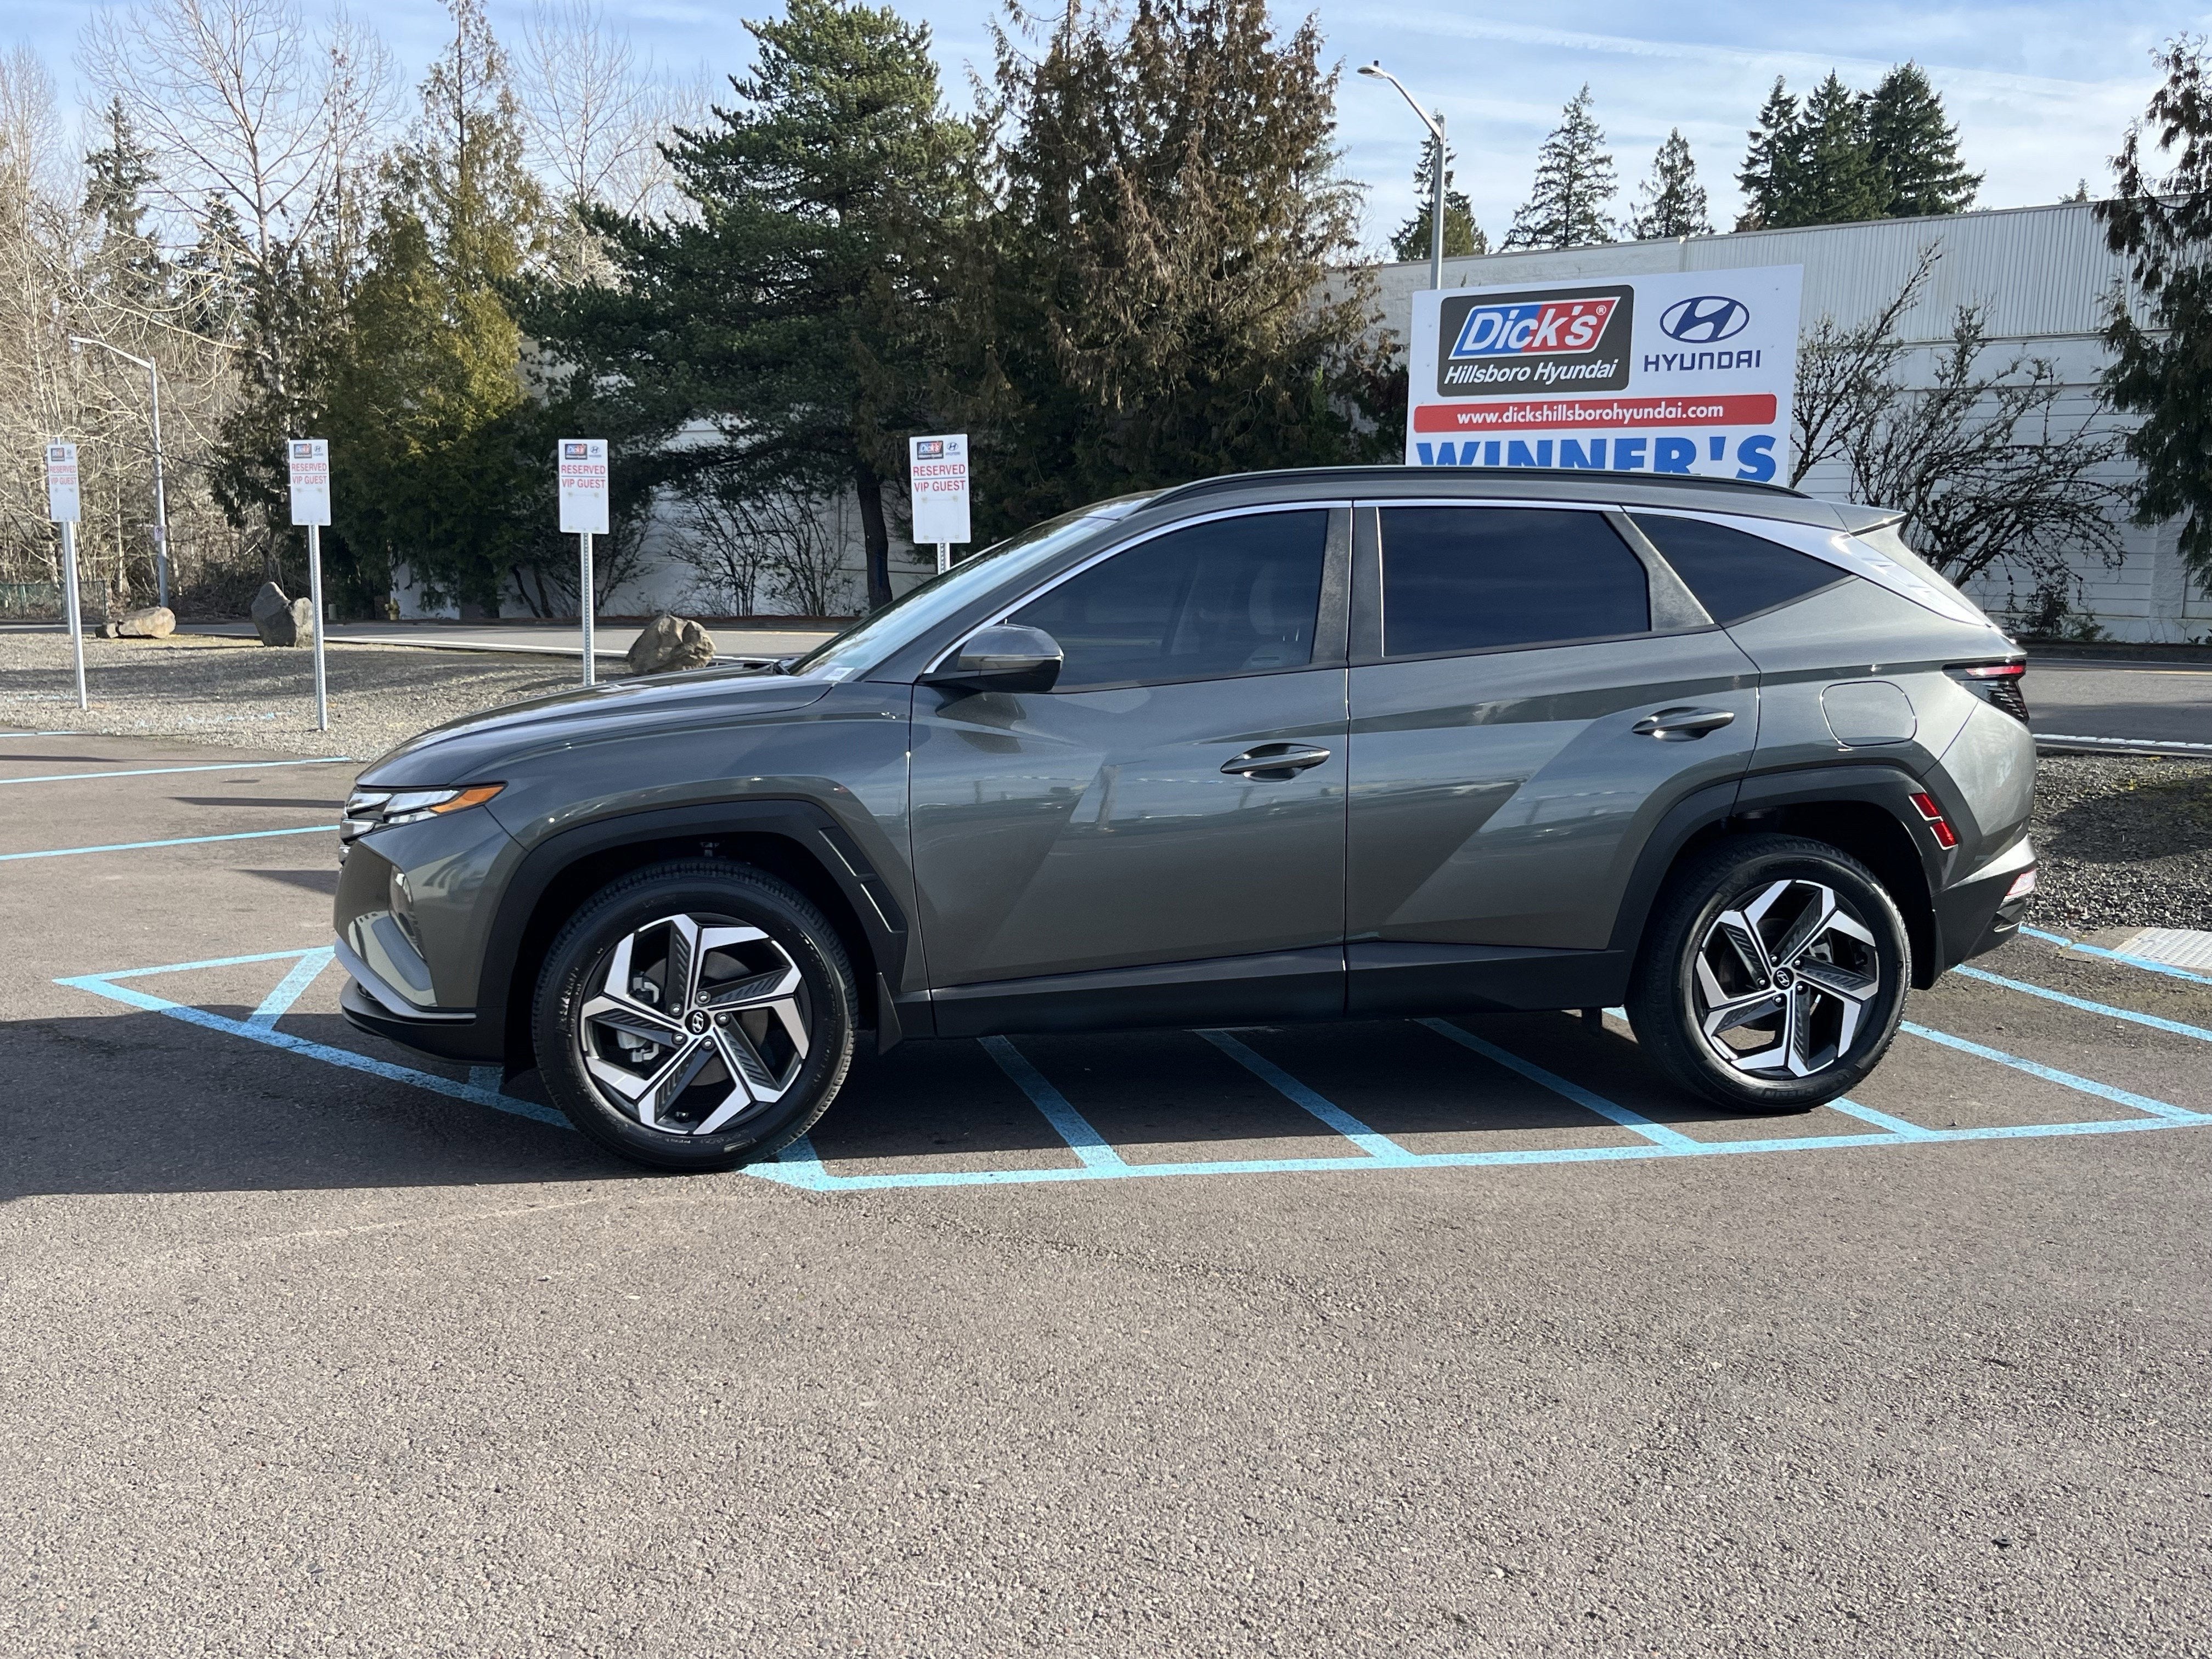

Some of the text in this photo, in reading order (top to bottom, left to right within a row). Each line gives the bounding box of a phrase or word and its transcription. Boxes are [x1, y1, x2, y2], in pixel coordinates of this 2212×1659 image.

[1644, 349, 1761, 372] HYUNDAI
[1443, 359, 1619, 385] Hillsboro Hyundai
[1457, 401, 1724, 425] www.dickshillsborohyundai.com
[291, 463, 327, 471] RESERVED
[561, 465, 606, 475] RESERVED
[913, 464, 966, 476] RESERVED
[292, 476, 327, 484] VIP GUEST
[562, 478, 606, 488] VIP GUEST
[914, 481, 966, 492] VIP GUEST
